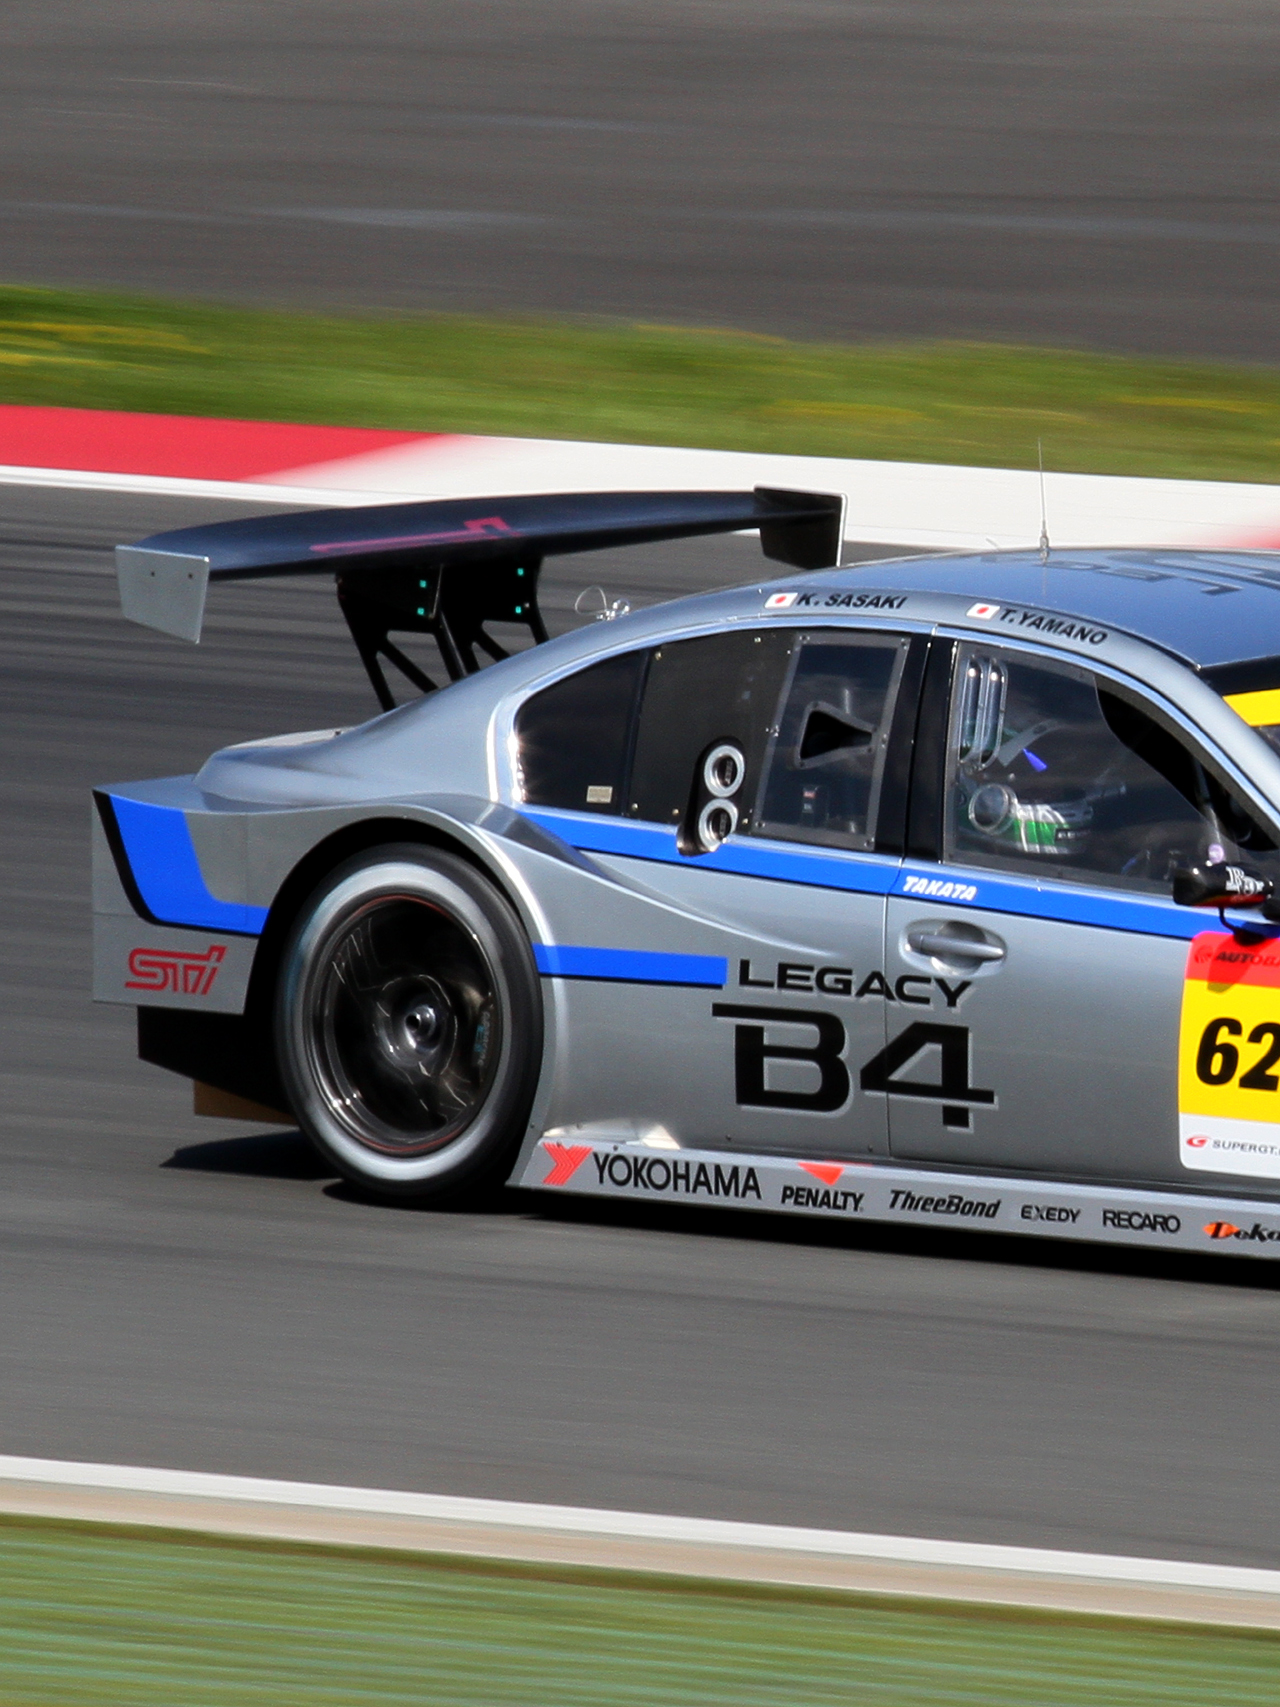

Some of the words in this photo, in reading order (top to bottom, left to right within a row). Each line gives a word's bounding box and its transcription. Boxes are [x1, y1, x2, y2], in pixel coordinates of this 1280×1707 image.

[824, 593, 907, 610] SASAKI
[999, 607, 1108, 646] T.YAMANO
[902, 876, 979, 901] TAKATA
[738, 958, 974, 1010] LEGACY
[712, 1002, 998, 1132] B4
[593, 1152, 763, 1200] YOKOHAMA
[781, 1185, 865, 1212] PENALTY
[889, 1189, 1002, 1219] ThreeBond
[1020, 1204, 1081, 1225] EXEDY
[1102, 1209, 1182, 1234] RECARO
